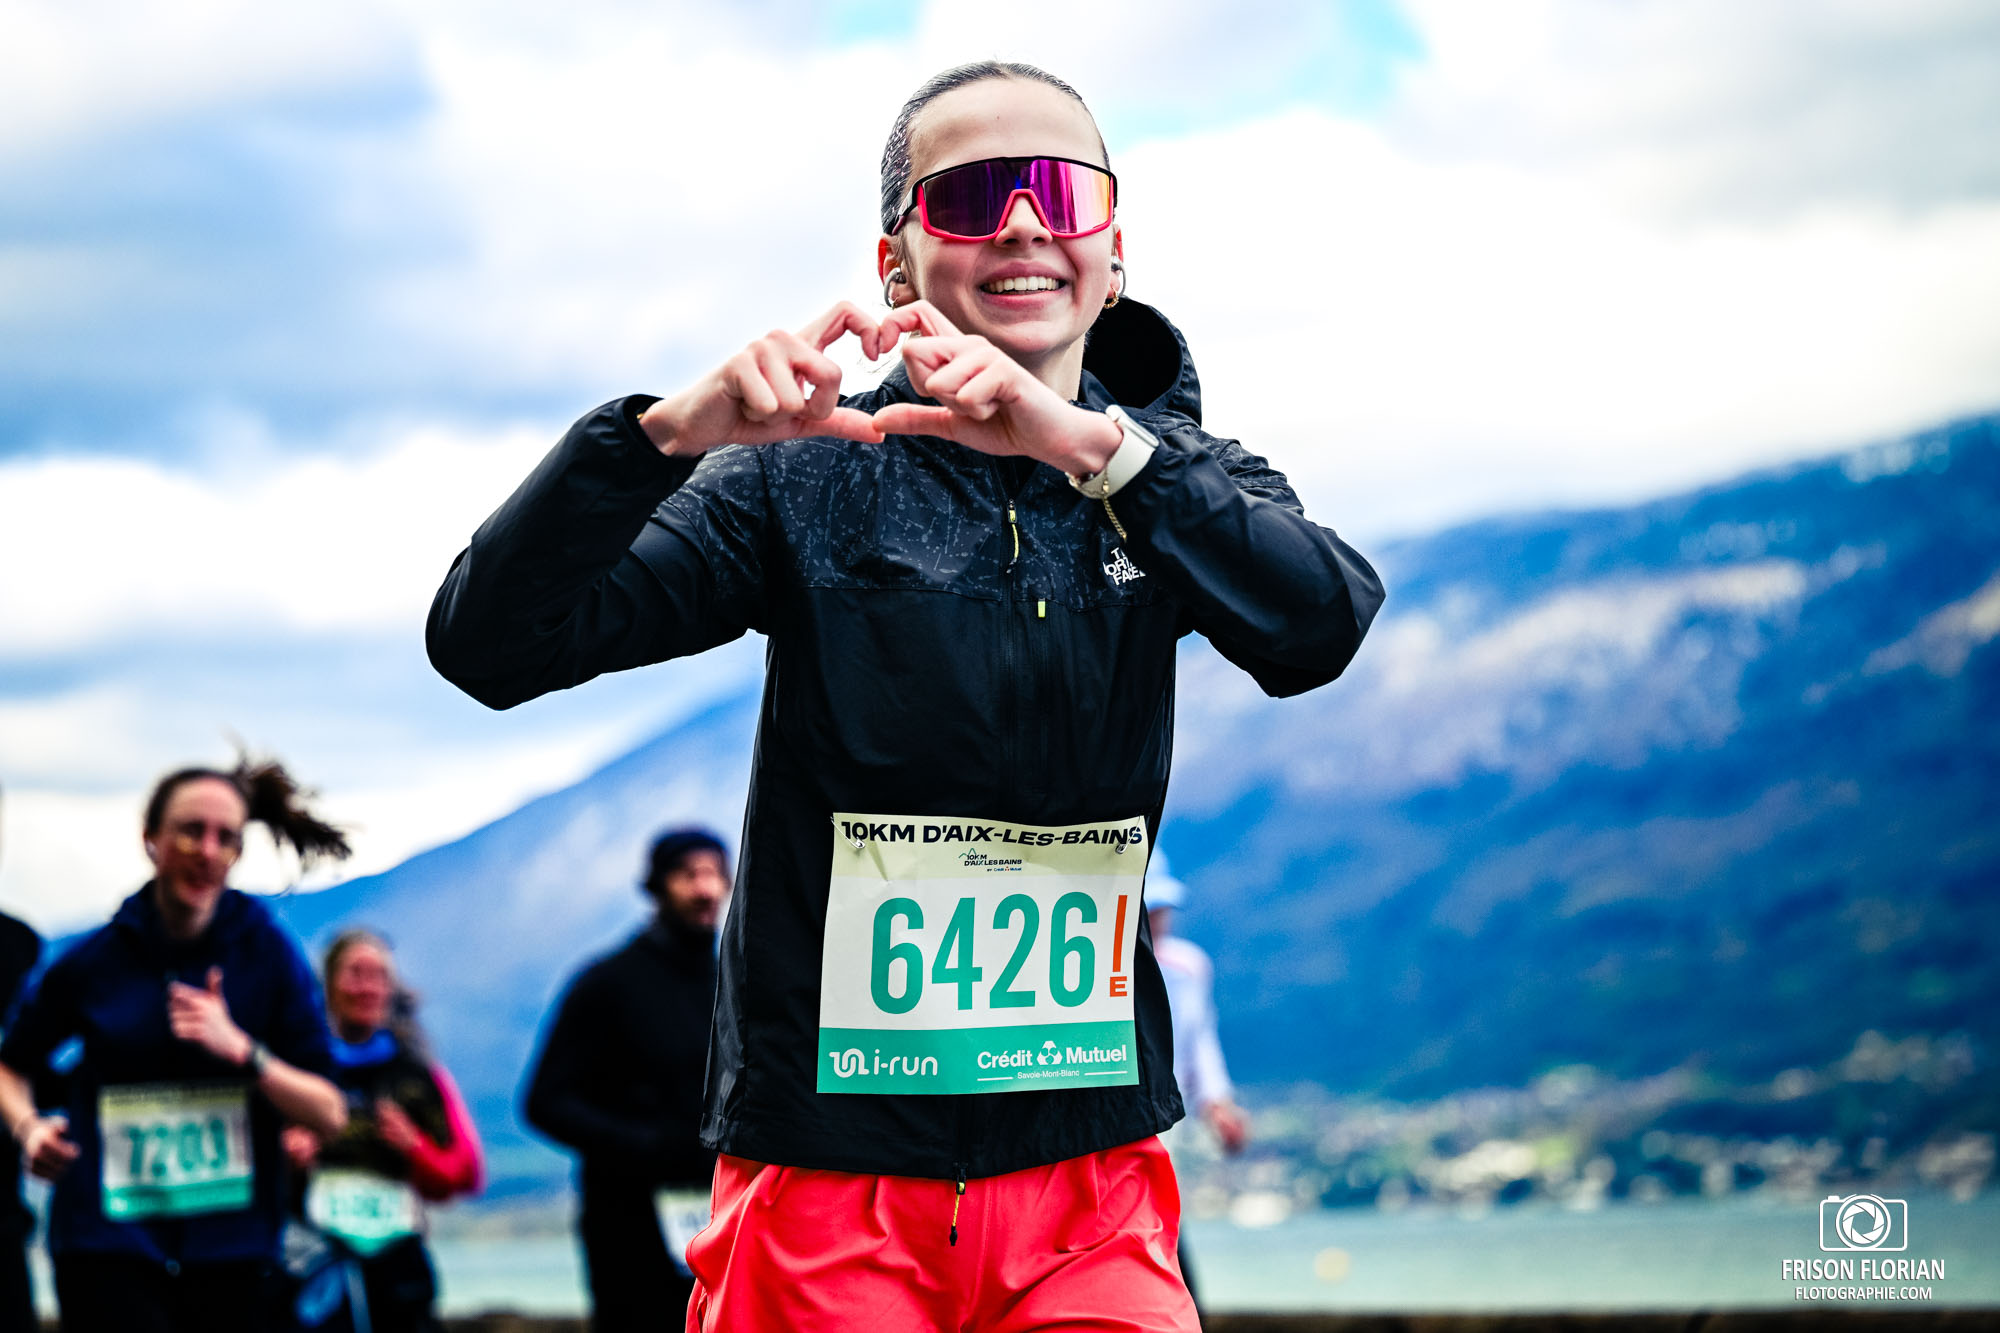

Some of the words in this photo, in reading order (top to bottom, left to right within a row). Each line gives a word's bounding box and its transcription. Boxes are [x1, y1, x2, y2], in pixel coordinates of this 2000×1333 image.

[841, 821, 915, 843] 10KM
[923, 825, 1143, 846] D'AIX-LES-BAINS
[870, 891, 1098, 1014] 6426
[1110, 976, 1128, 997] E
[874, 1048, 938, 1076] i-run
[977, 1049, 1033, 1069] Crédit
[1066, 1044, 1127, 1064] Mutuel
[1017, 1069, 1080, 1080] Savoie-Mont-Blanc
